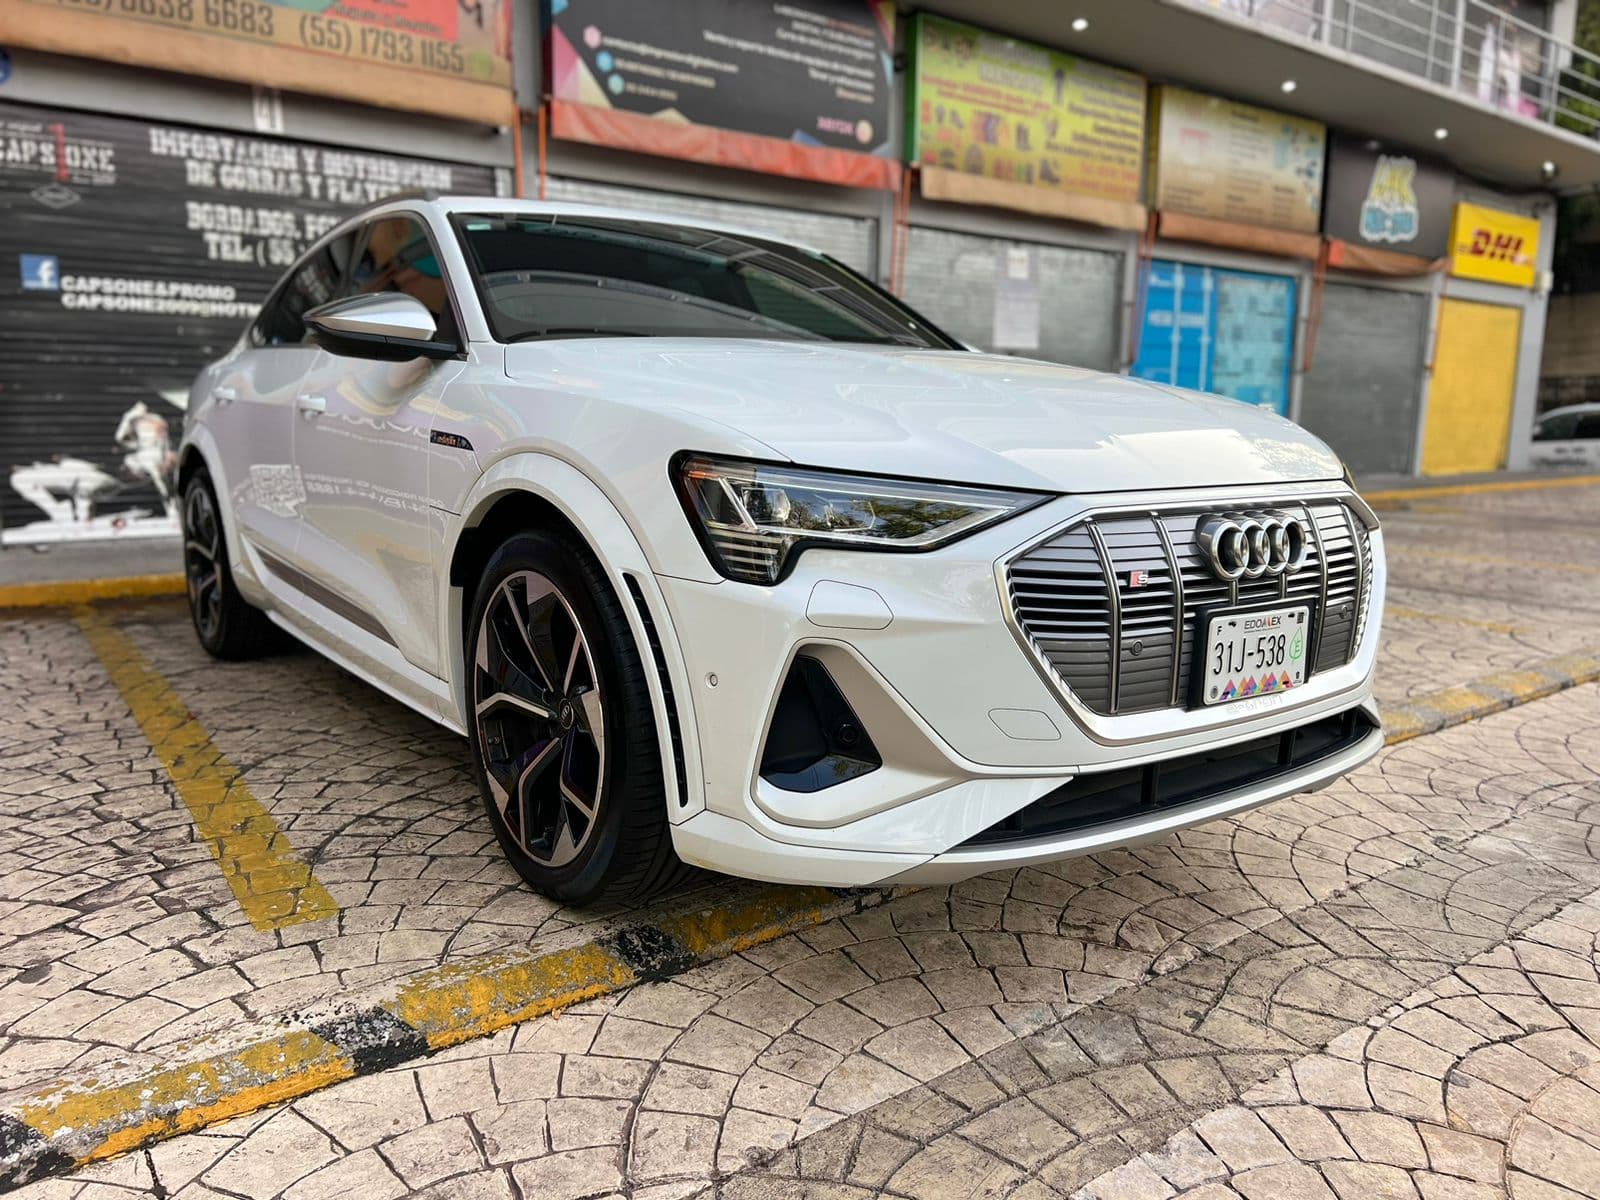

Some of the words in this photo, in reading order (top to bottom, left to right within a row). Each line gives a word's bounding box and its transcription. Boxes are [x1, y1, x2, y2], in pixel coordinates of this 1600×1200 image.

[204, 0, 275, 37] 6683
[299, 15, 352, 54] (55)
[360, 28, 414, 64] 1793
[420, 40, 465, 73] 1155
[185, 158, 217, 186] DE
[1471, 229, 1530, 266] DHL
[1213, 634, 1286, 676] 31J-538
